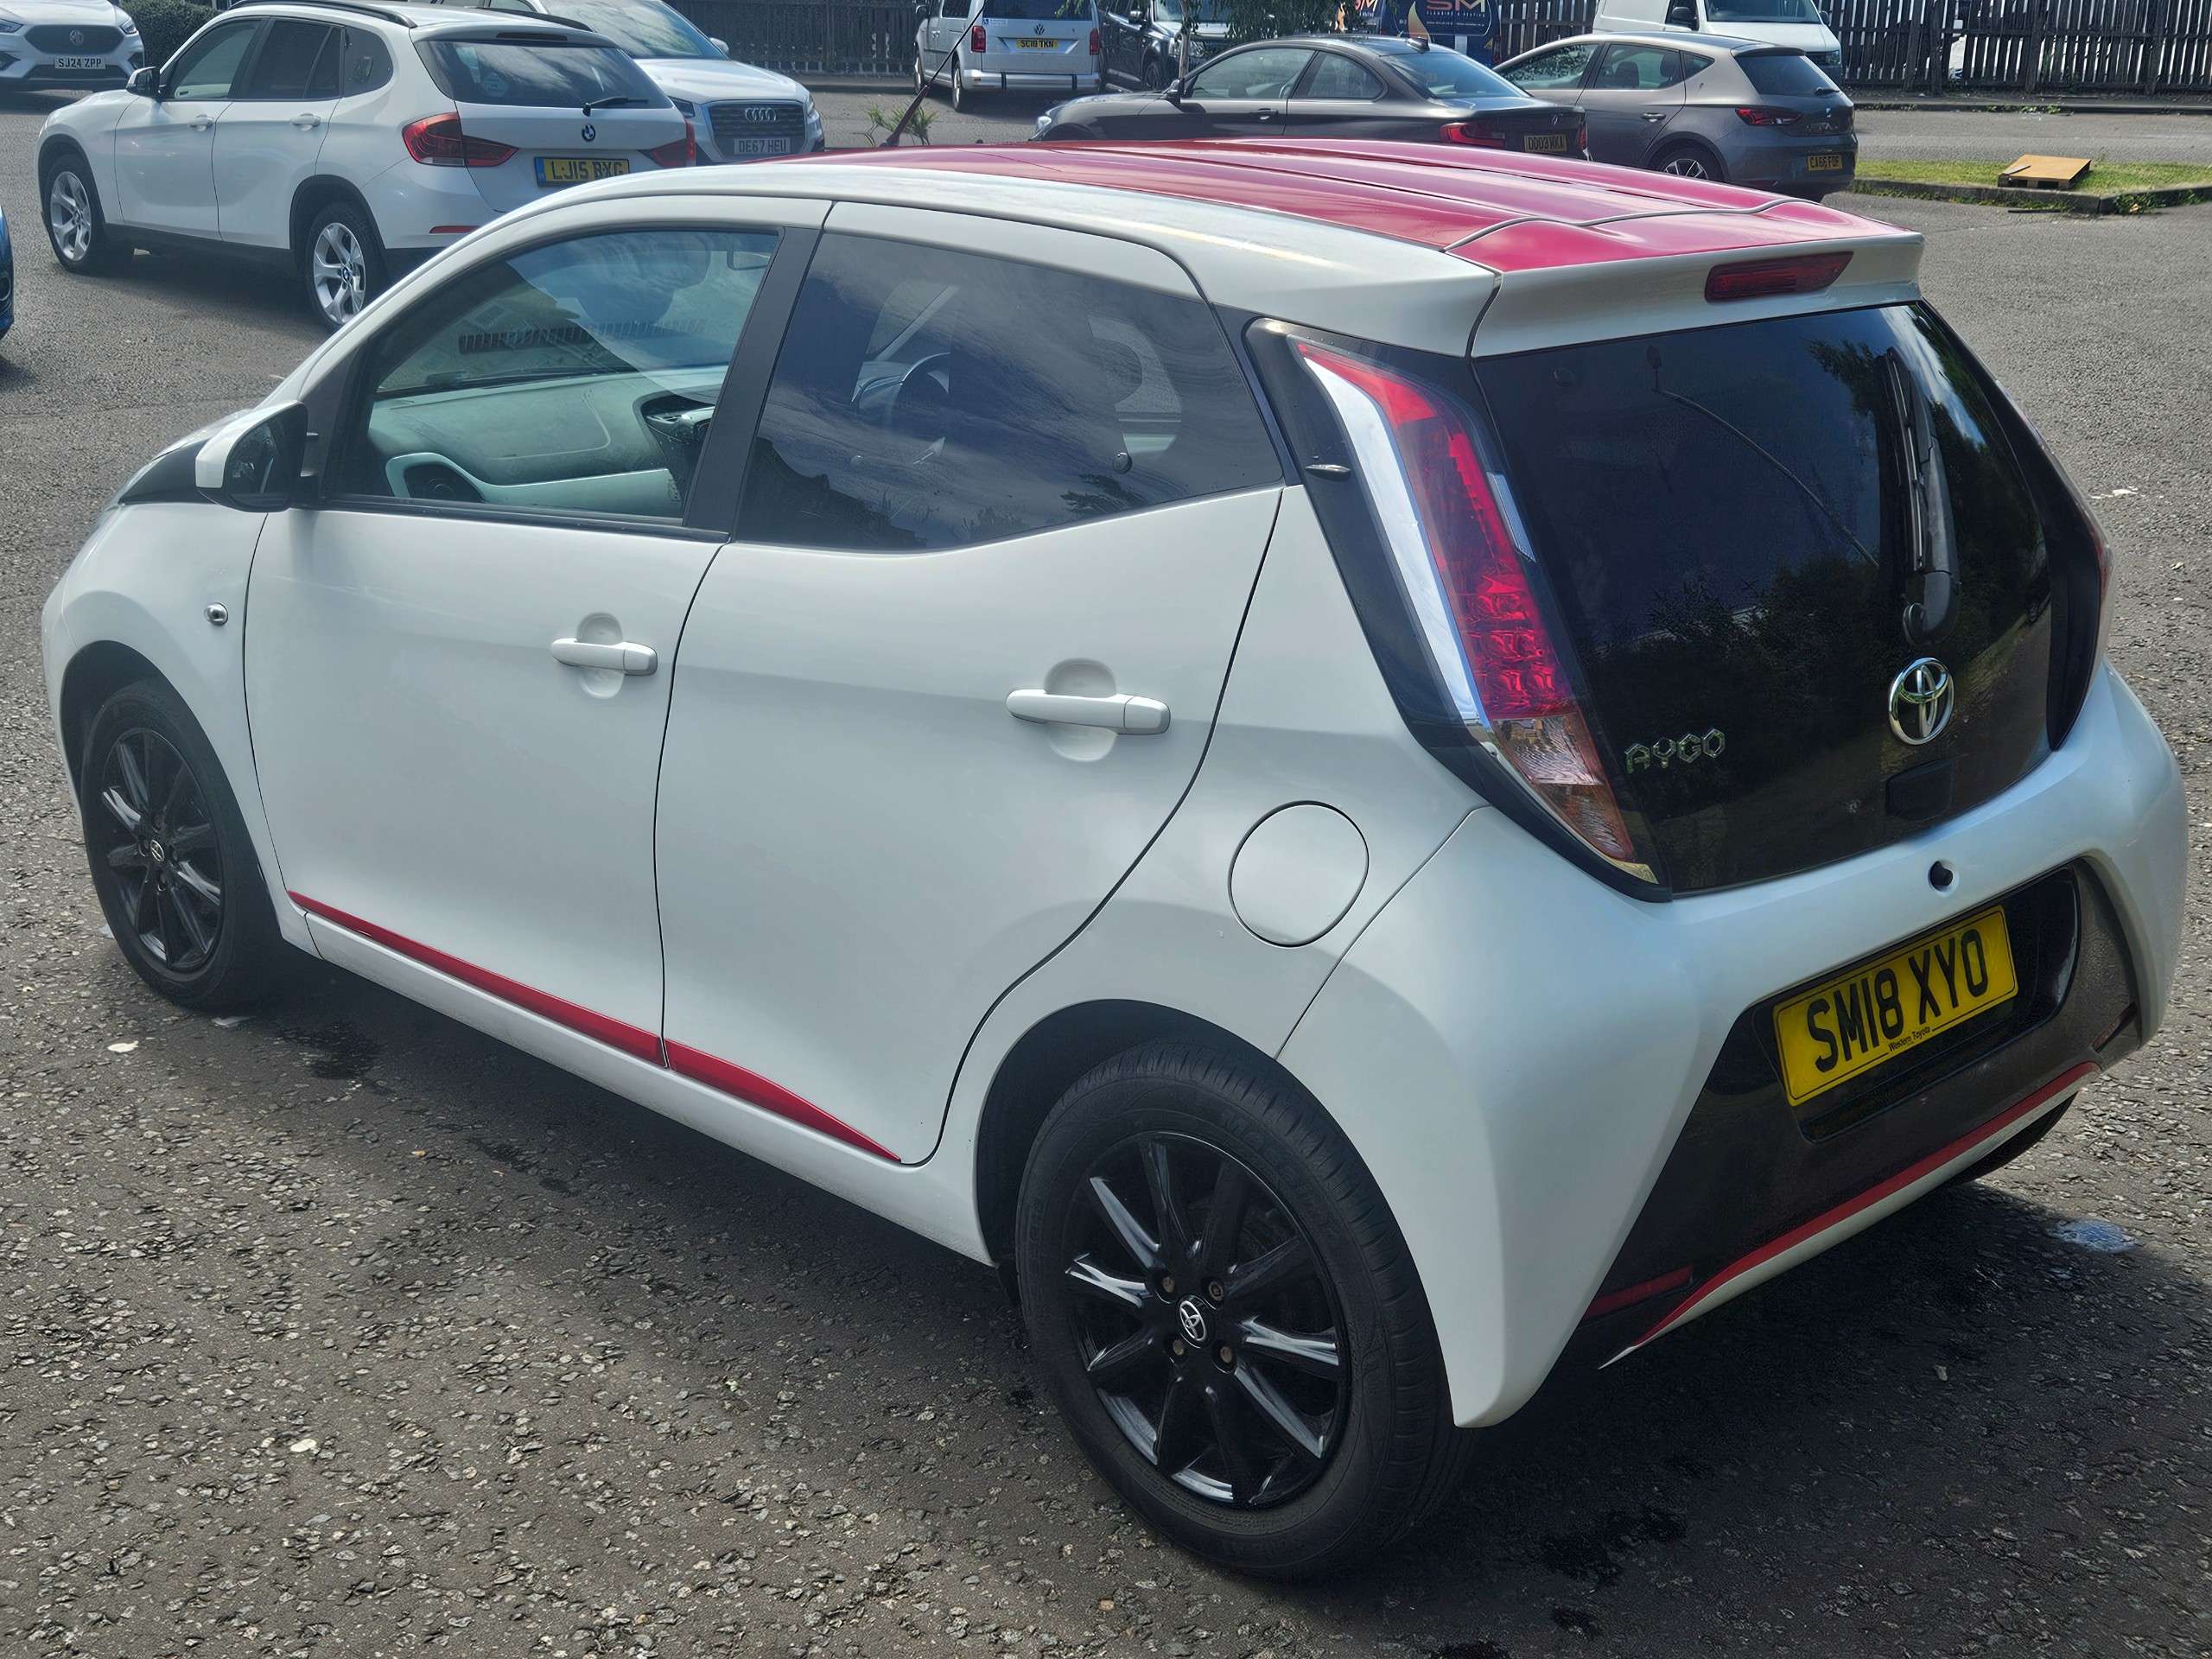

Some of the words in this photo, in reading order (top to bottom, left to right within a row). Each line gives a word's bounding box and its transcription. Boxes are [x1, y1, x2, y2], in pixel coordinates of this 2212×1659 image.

[58, 57, 82, 68] SJ24
[84, 57, 102, 68] ZPP
[739, 139, 766, 153] DE67
[551, 161, 588, 181] LJ15
[1624, 728, 1726, 774] AYGO
[1807, 967, 1904, 1073] SM18
[1908, 928, 1989, 1025] XYO
